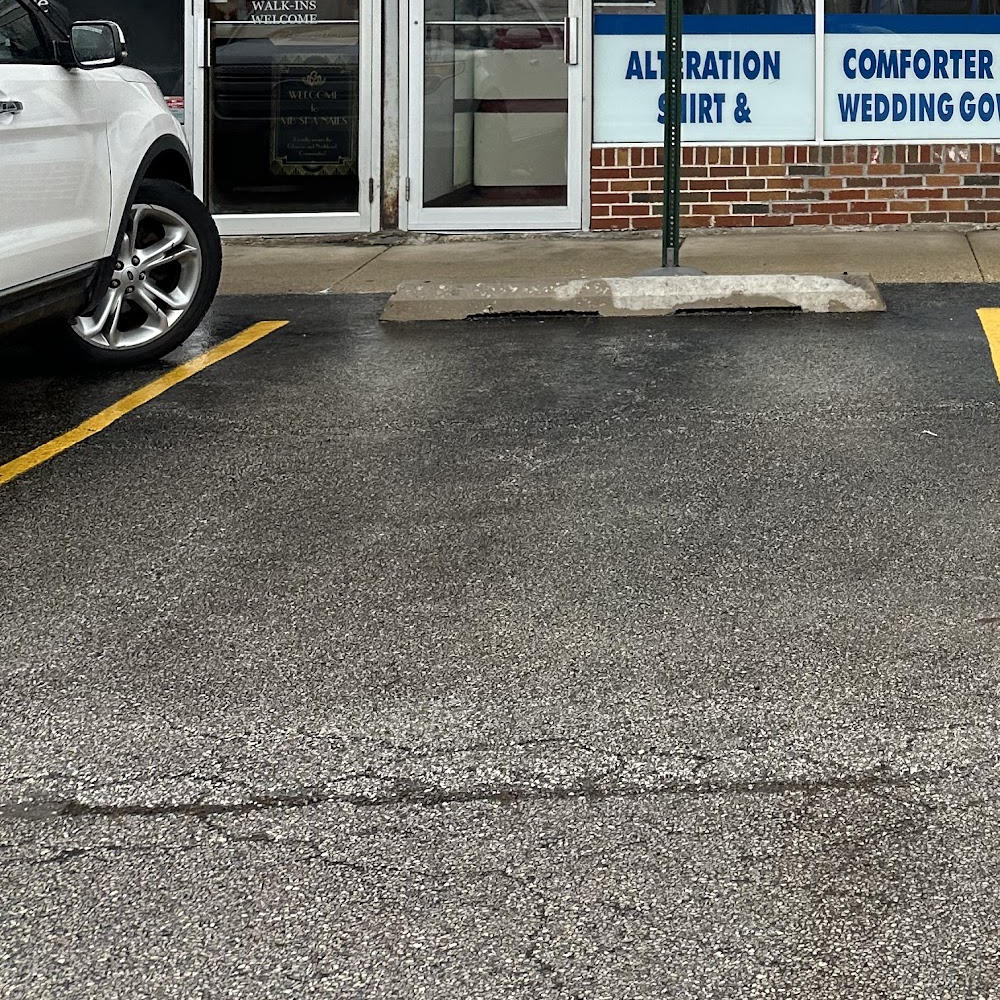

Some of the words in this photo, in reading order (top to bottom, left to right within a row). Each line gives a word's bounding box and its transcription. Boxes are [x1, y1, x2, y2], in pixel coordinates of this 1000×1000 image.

[251, 14, 318, 25] WELCOME
[252, 0, 317, 11] WALK-INS
[625, 50, 781, 81] ALTRATION
[843, 48, 995, 80] COMFORTER
[288, 90, 338, 100] WELCOME
[734, 92, 752, 124] &
[837, 93, 954, 122] WEDDING
